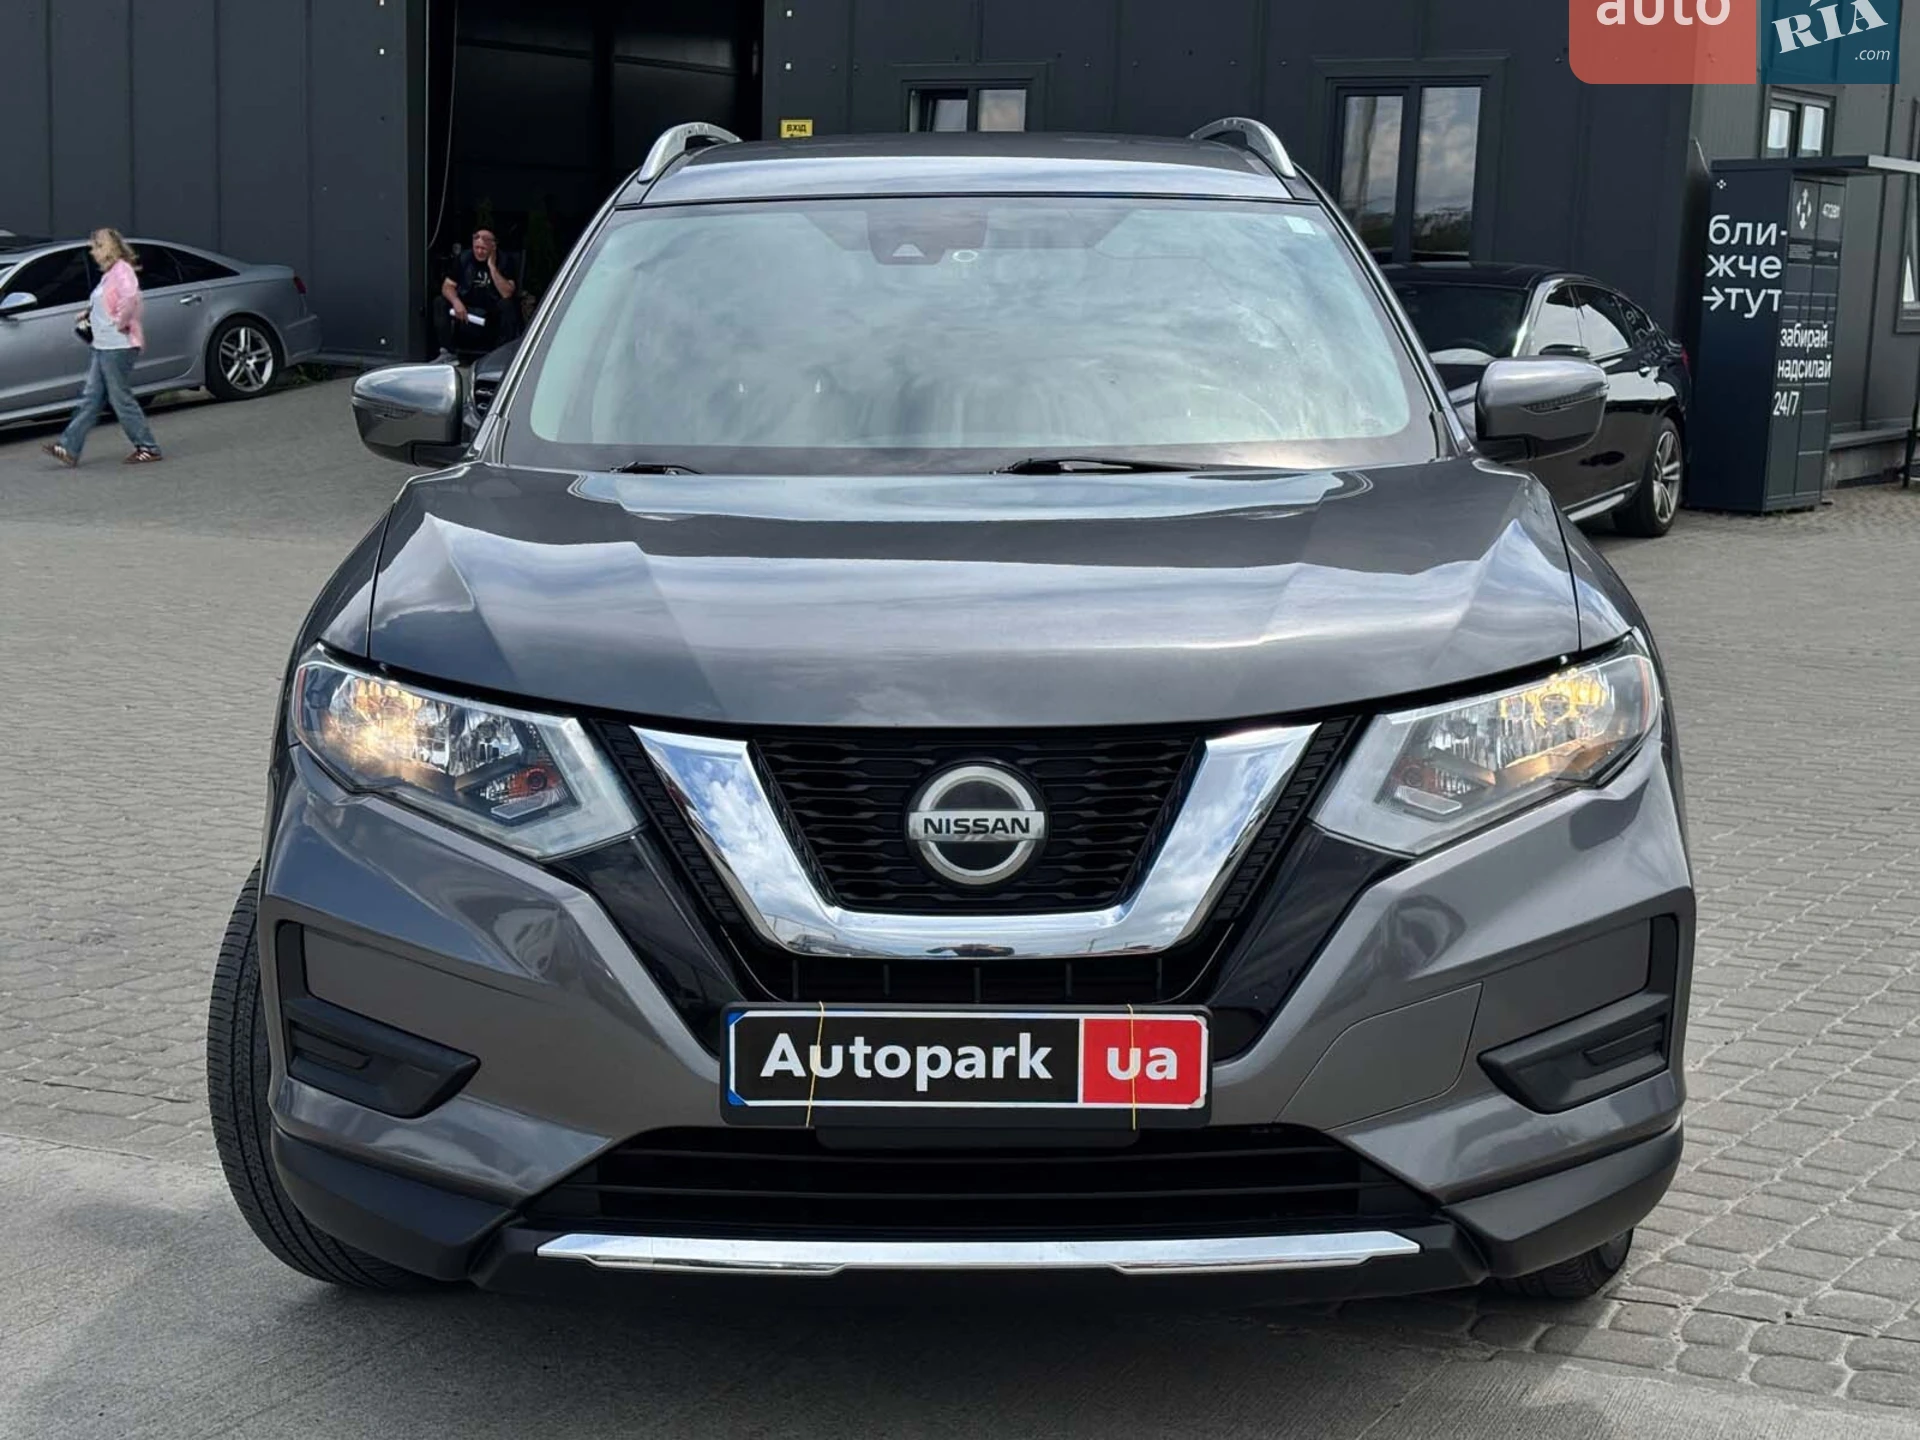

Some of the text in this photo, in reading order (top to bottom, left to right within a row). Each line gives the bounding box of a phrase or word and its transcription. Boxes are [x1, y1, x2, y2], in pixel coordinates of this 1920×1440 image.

[1708, 214, 1788, 246] бли-
[1705, 253, 1782, 279] жче
[1724, 287, 1782, 319] тут
[1779, 323, 1829, 353] забирай
[1776, 354, 1832, 381] надсилай
[1772, 390, 1800, 417] 24/7
[923, 817, 1030, 835] NISSAN
[759, 1032, 1178, 1092] Autopark ua
